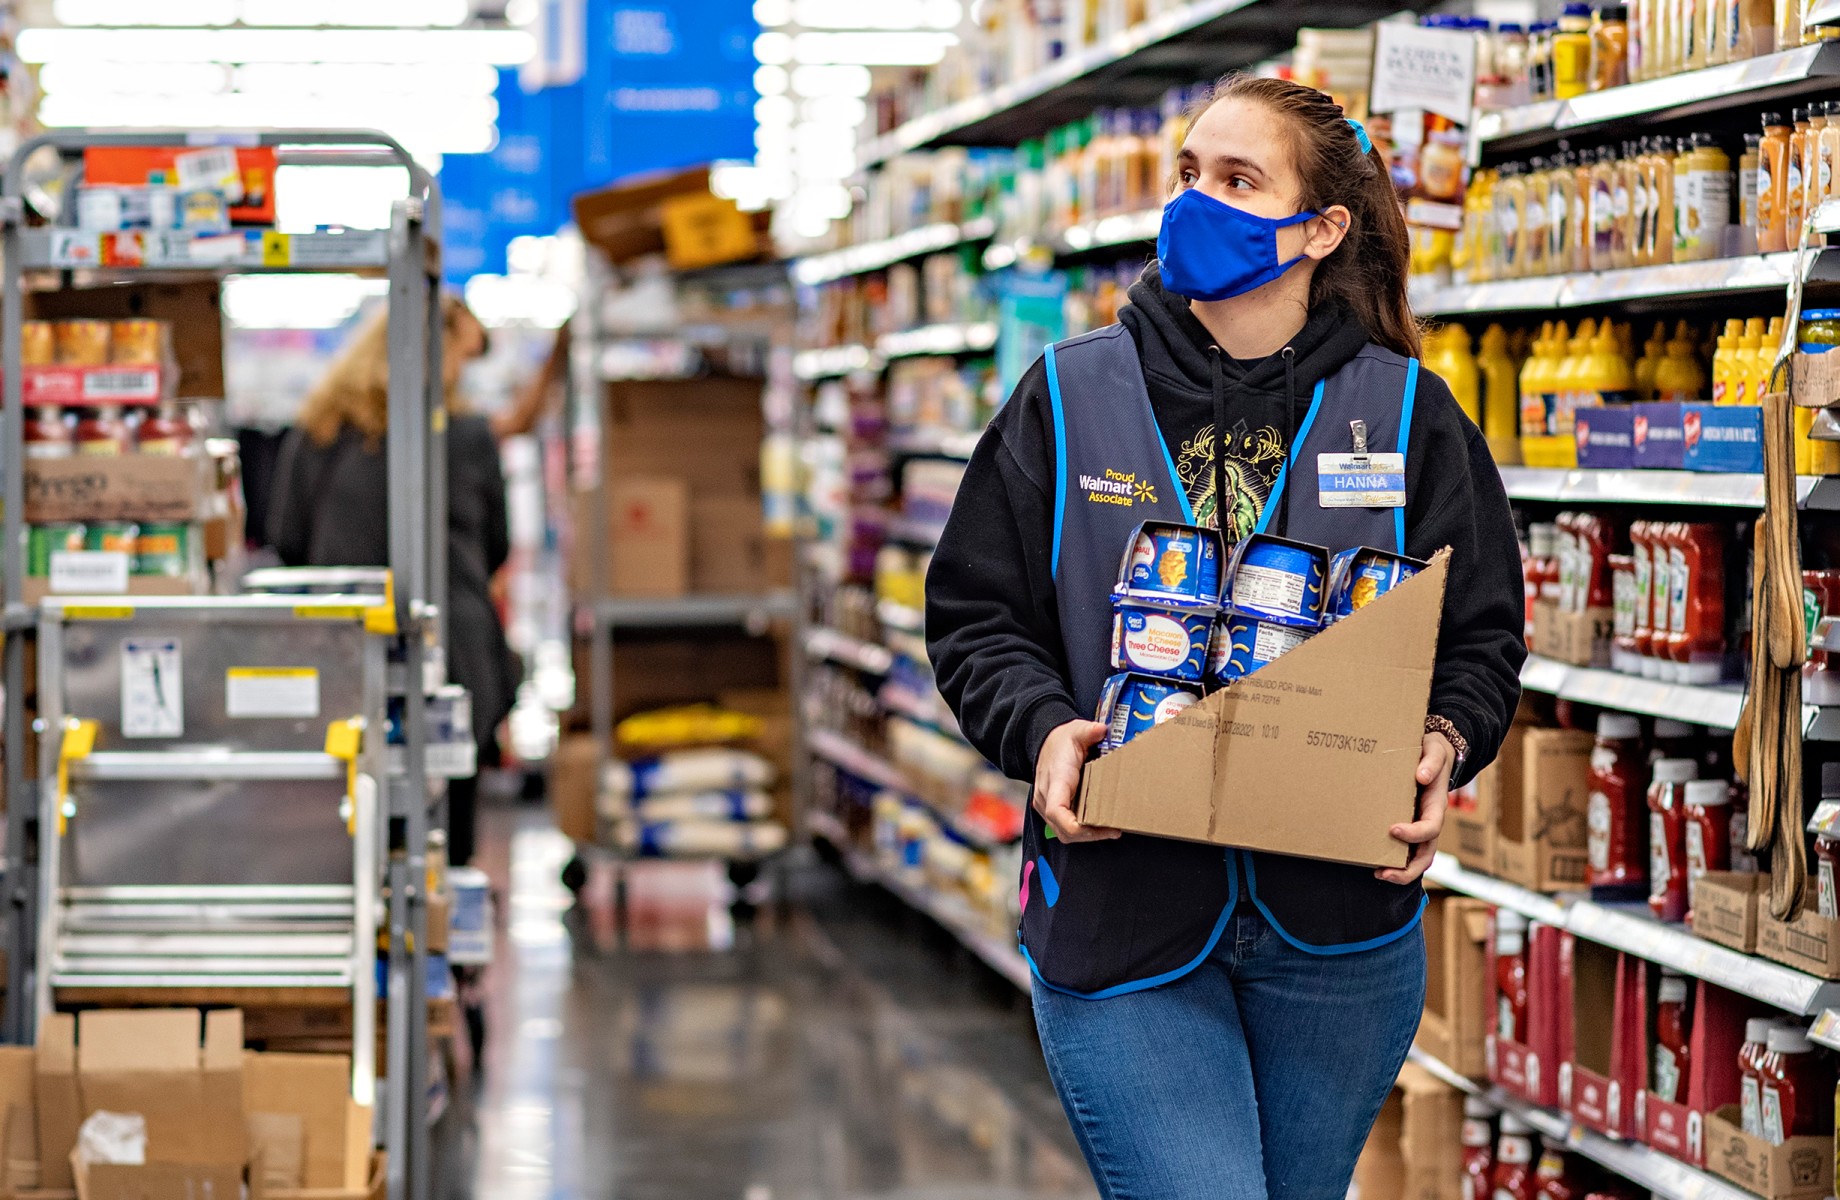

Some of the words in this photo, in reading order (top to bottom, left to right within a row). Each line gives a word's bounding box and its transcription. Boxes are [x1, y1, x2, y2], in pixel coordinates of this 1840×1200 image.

[1106, 468, 1135, 482] Proud
[1080, 474, 1132, 494] Walmart
[1334, 476, 1388, 488] HANNA
[1088, 492, 1133, 506] Associate
[1128, 616, 1142, 624] Great
[1148, 628, 1184, 640] Macaroni
[1258, 628, 1273, 636] Facts
[1260, 624, 1284, 632] Nutrition
[1128, 640, 1146, 650] Three
[1147, 643, 1180, 656] Cheese
[1154, 636, 1182, 648] Cheese
[1262, 724, 1280, 739] 10:10
[1306, 730, 1377, 754] 557073K1367
